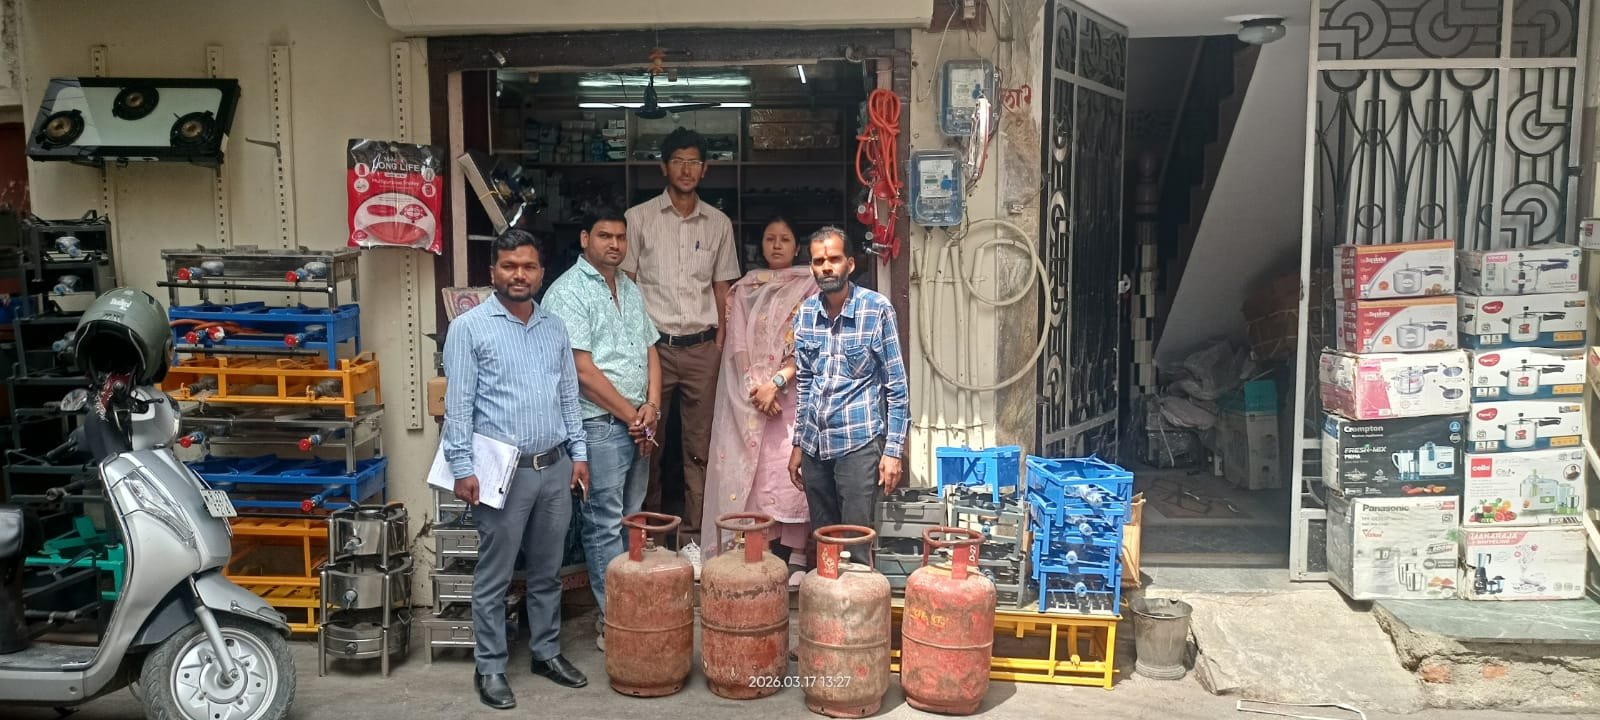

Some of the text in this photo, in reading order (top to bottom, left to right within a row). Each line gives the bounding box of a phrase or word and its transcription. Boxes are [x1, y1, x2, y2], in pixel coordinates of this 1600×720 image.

[400, 163, 420, 171] LIFE
[1472, 464, 1491, 472] cello
[1362, 503, 1409, 512] Panasonic
